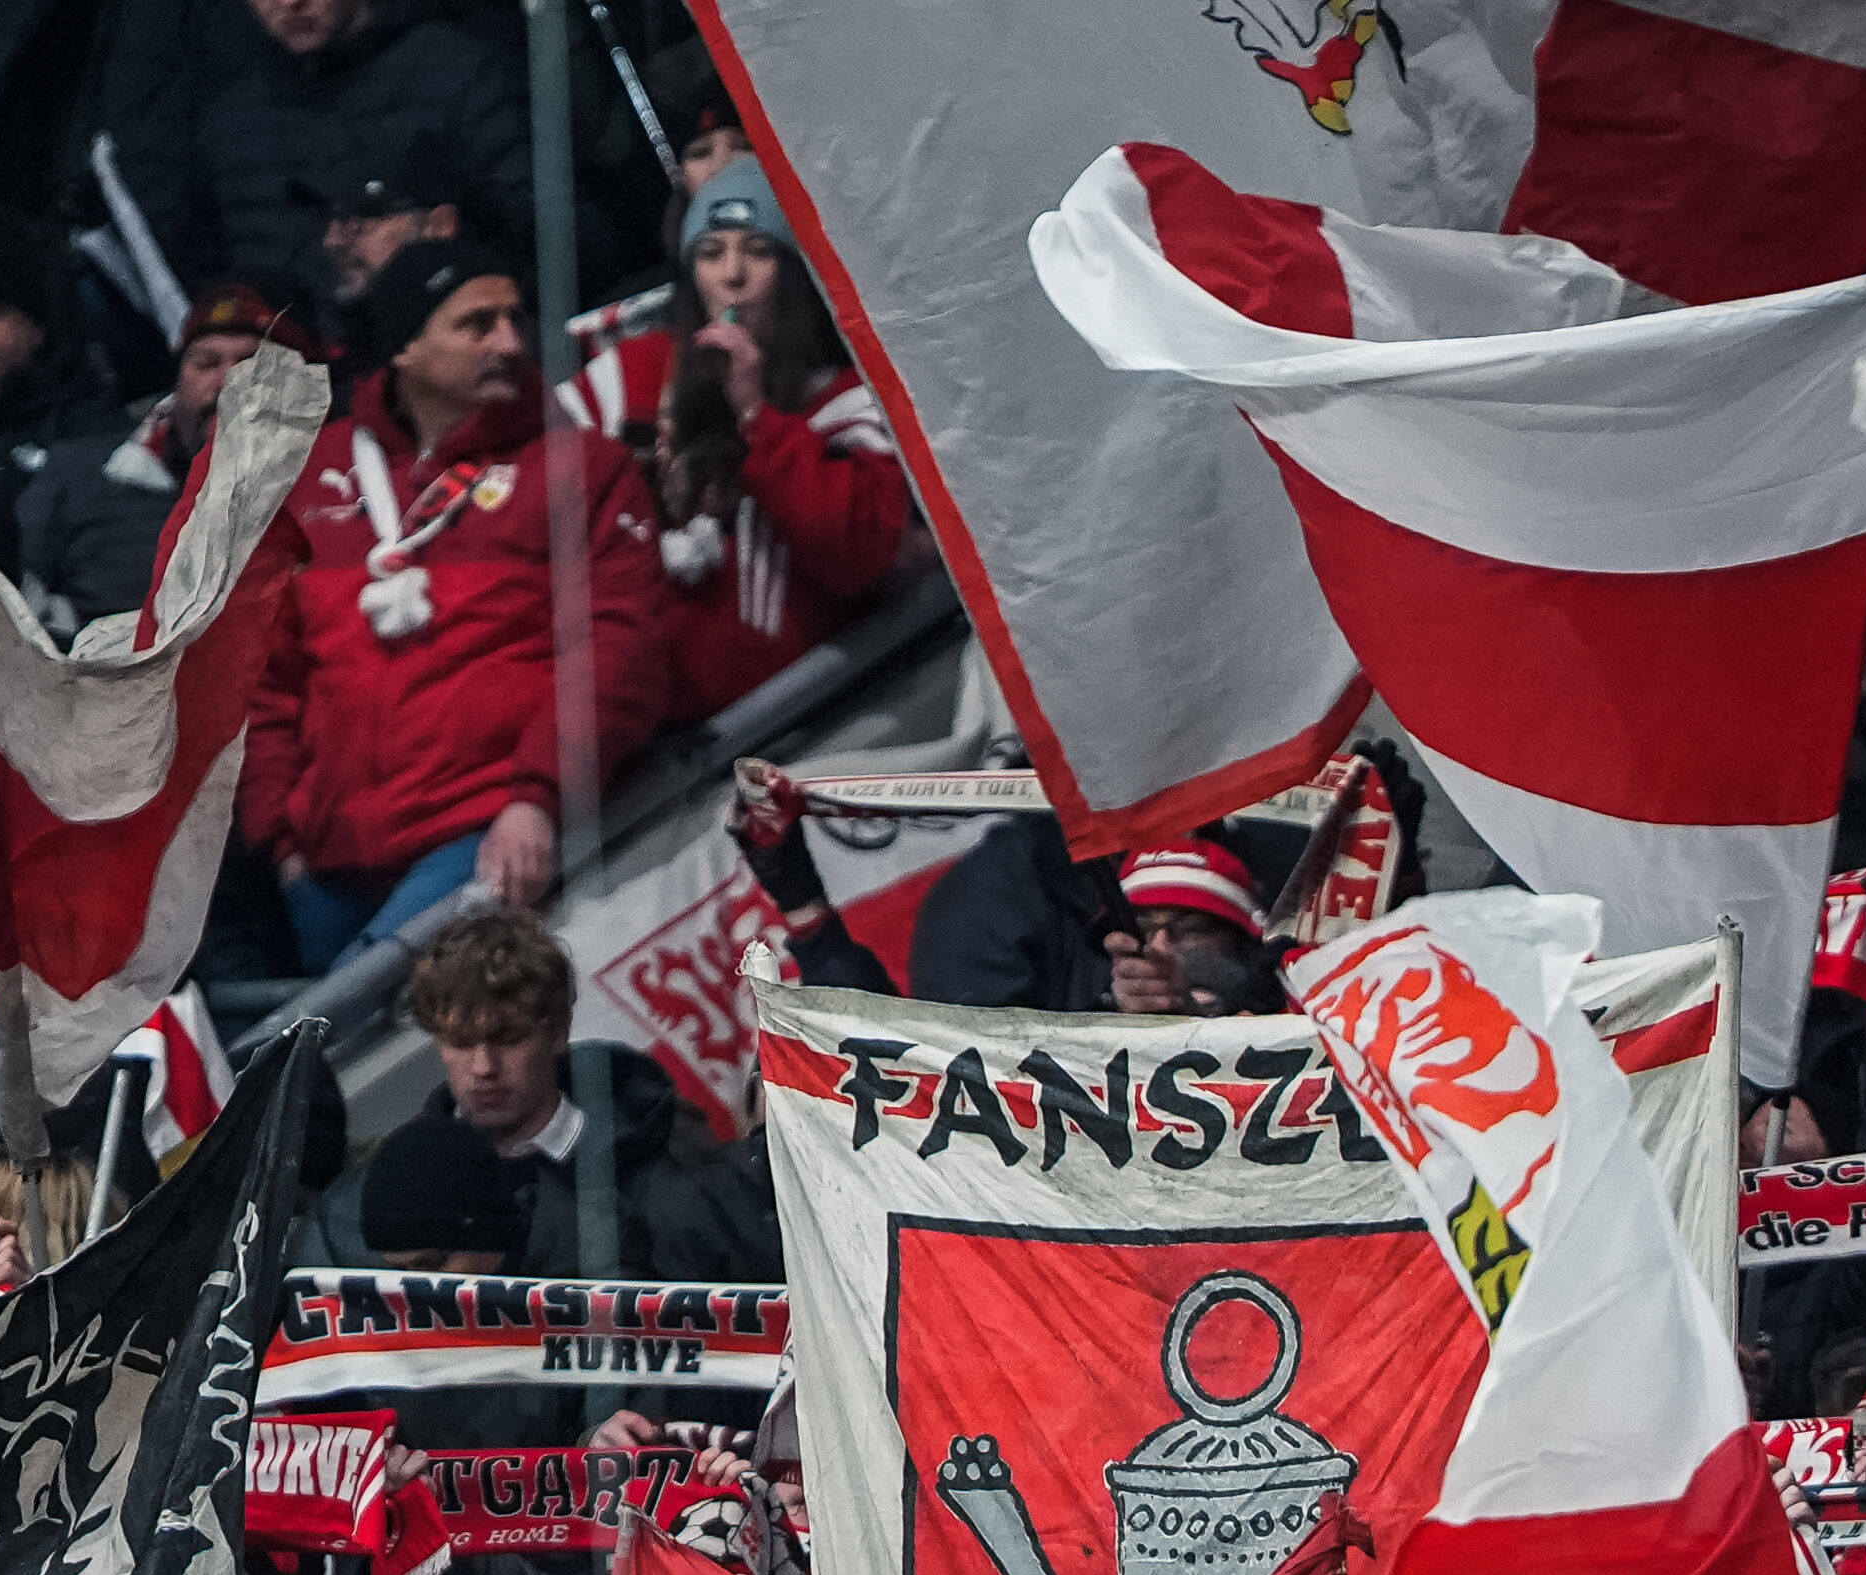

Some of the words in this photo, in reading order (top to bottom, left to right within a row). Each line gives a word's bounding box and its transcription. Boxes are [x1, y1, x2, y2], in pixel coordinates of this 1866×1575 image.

[1744, 1211, 1831, 1251] die
[541, 1335, 706, 1374] KURVE
[484, 1524, 570, 1546] HOME
